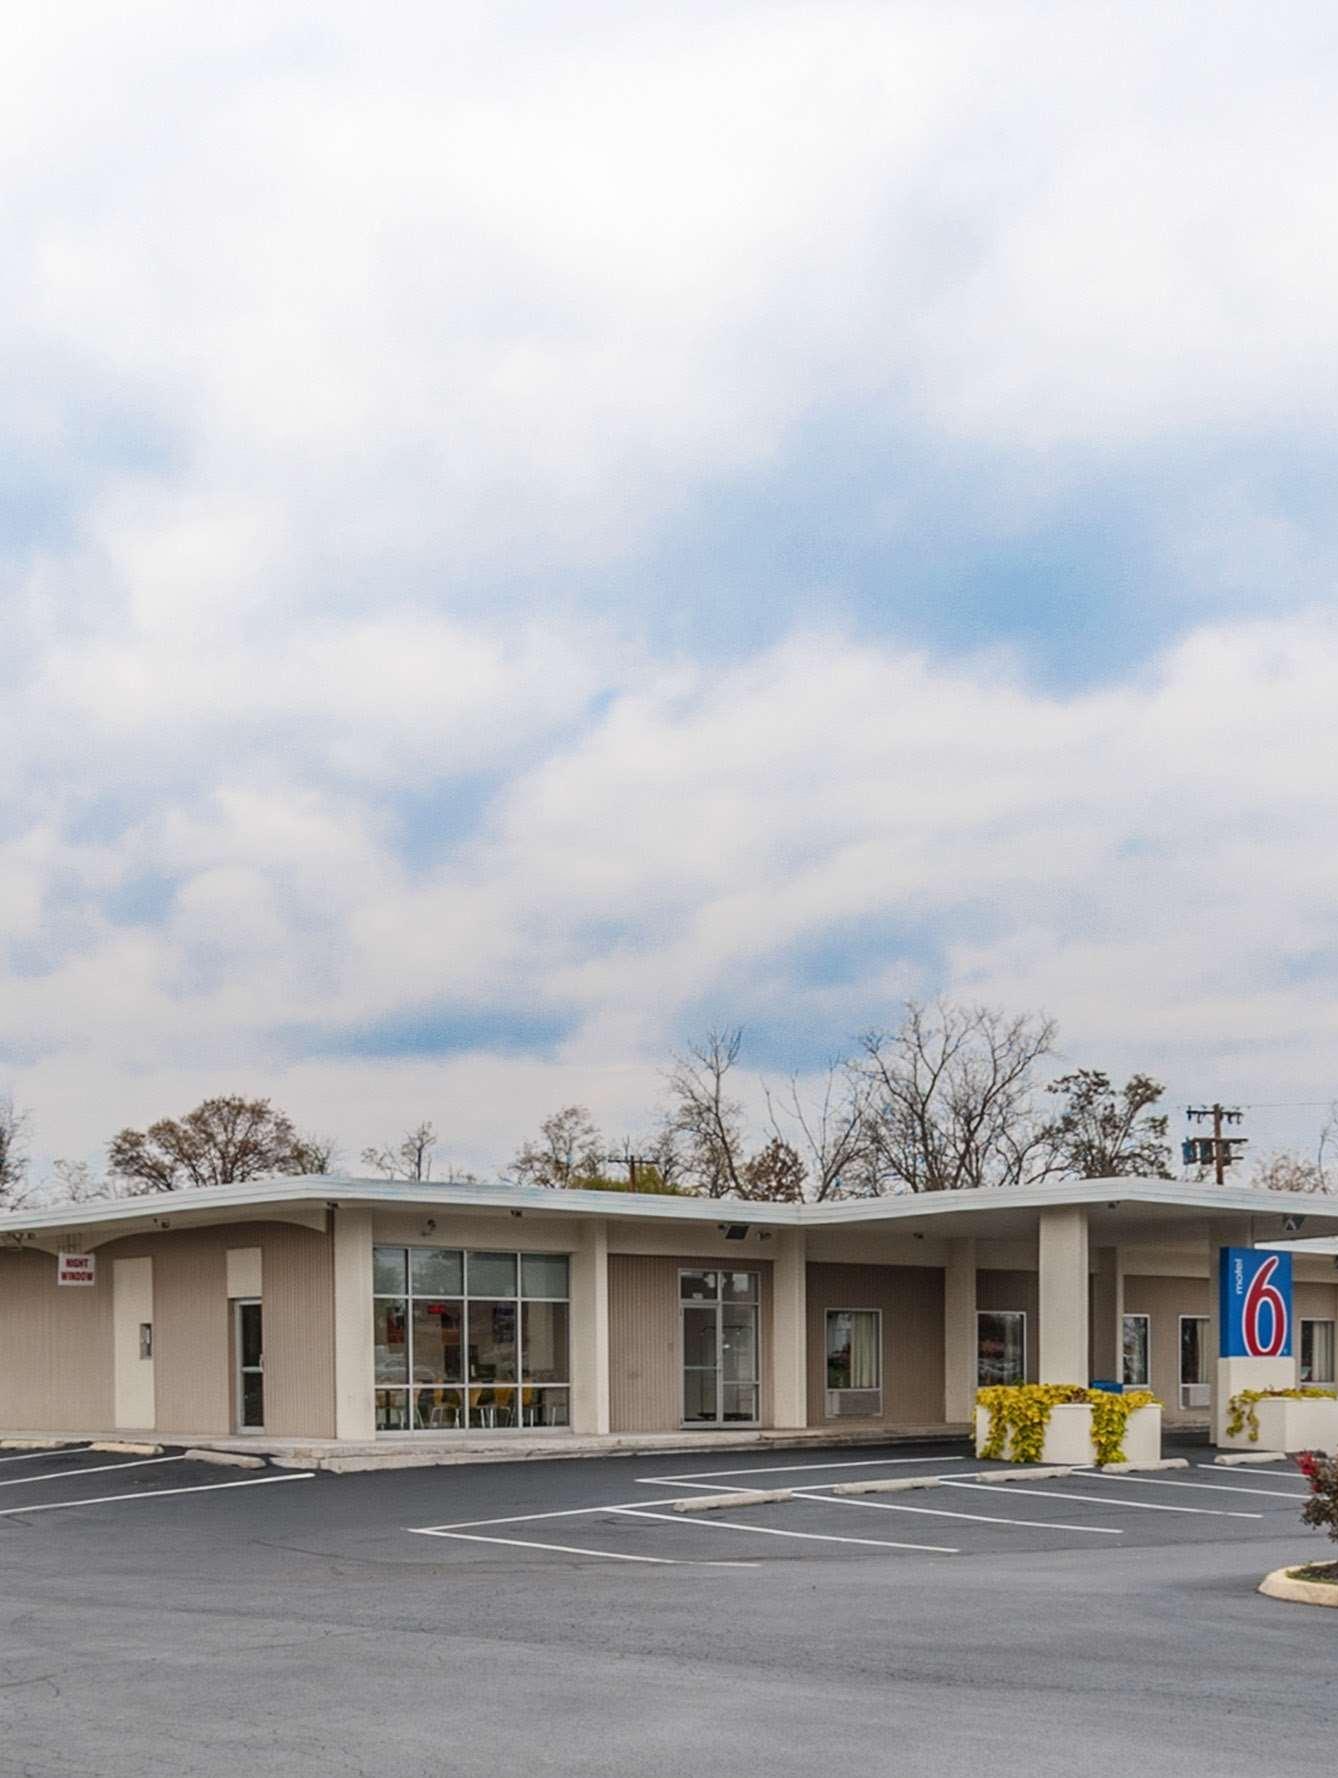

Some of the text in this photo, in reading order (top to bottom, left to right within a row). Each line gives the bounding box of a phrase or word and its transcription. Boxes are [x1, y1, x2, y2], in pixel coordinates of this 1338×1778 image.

[61, 1271, 93, 1281] WINDOW
[1233, 1255, 1288, 1357] motel 6
